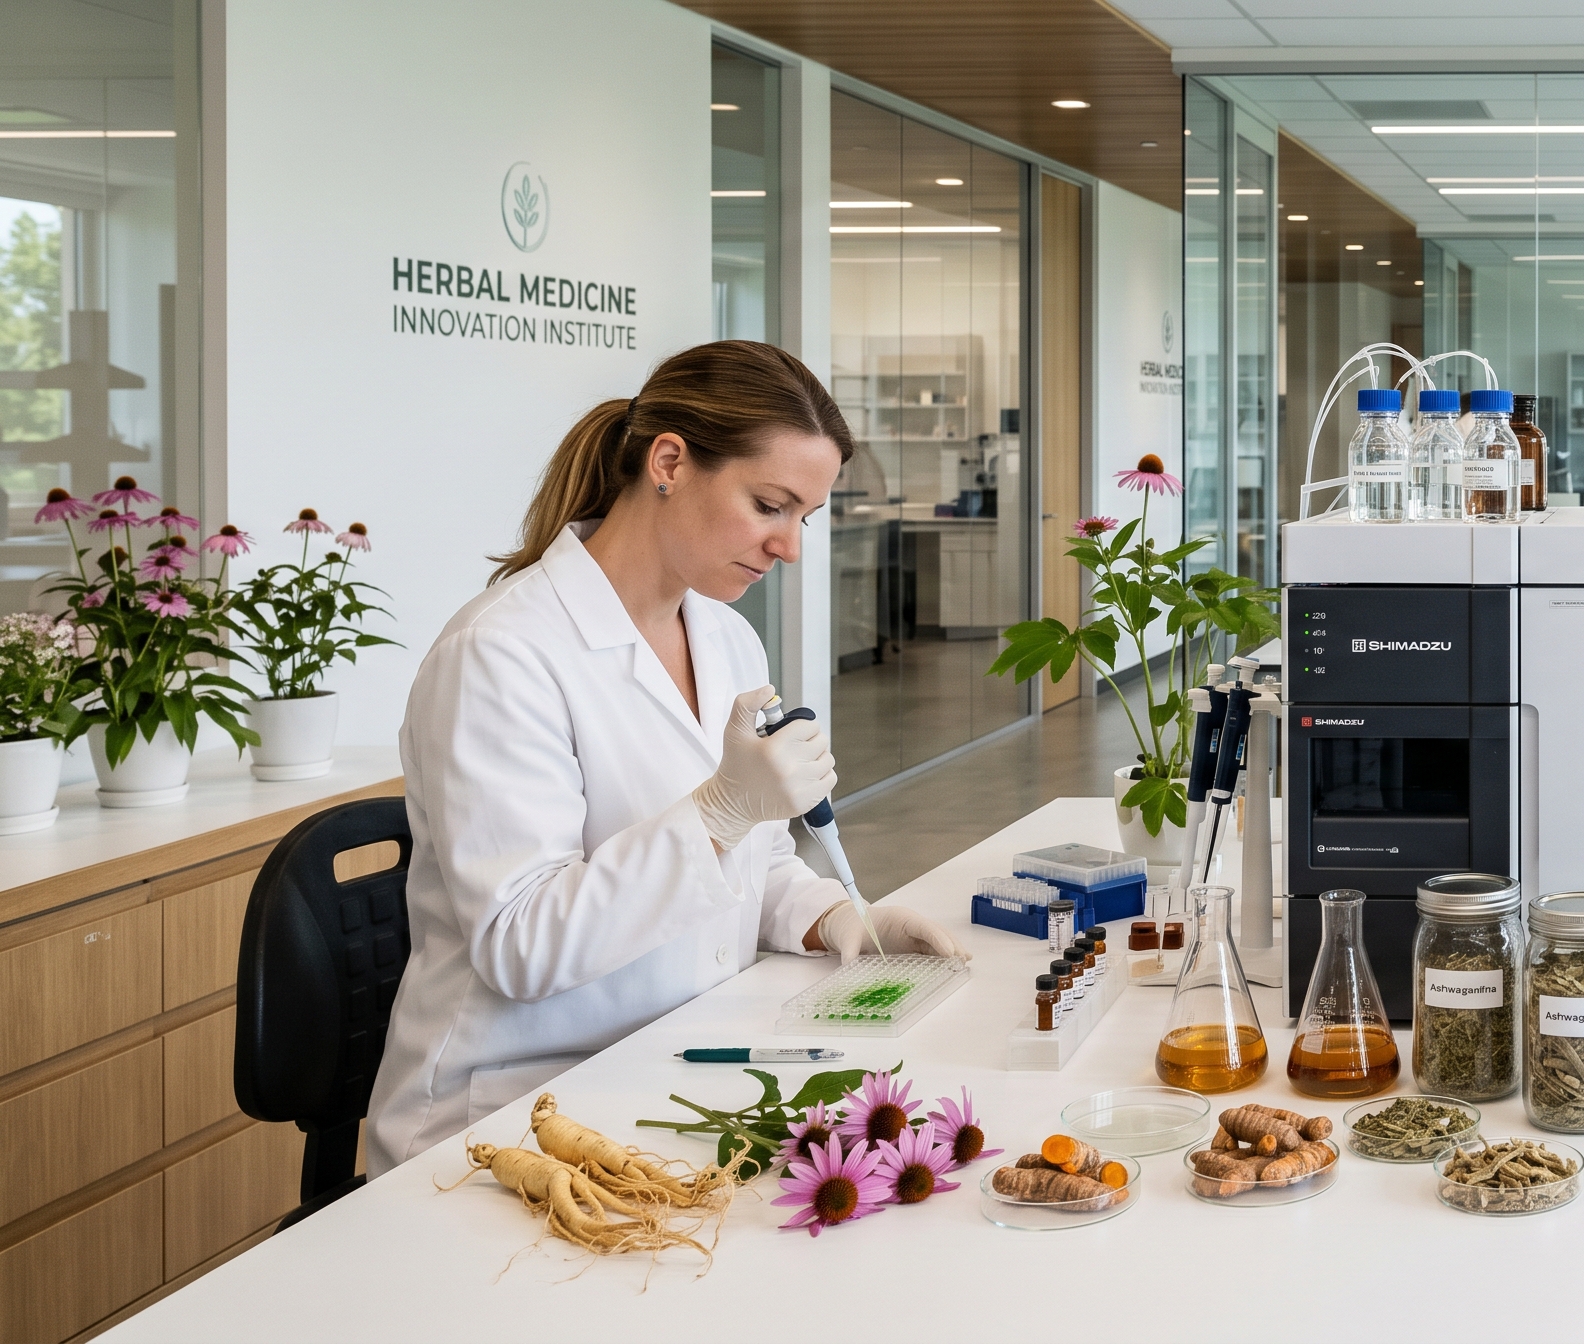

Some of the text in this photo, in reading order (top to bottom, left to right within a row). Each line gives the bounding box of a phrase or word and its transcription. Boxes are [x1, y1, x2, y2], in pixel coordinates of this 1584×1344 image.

[393, 256, 637, 316] HERBAL MEDICINE
[393, 304, 637, 350] INNOVATION INSTITUTE
[1368, 641, 1452, 651] SHIMADZU
